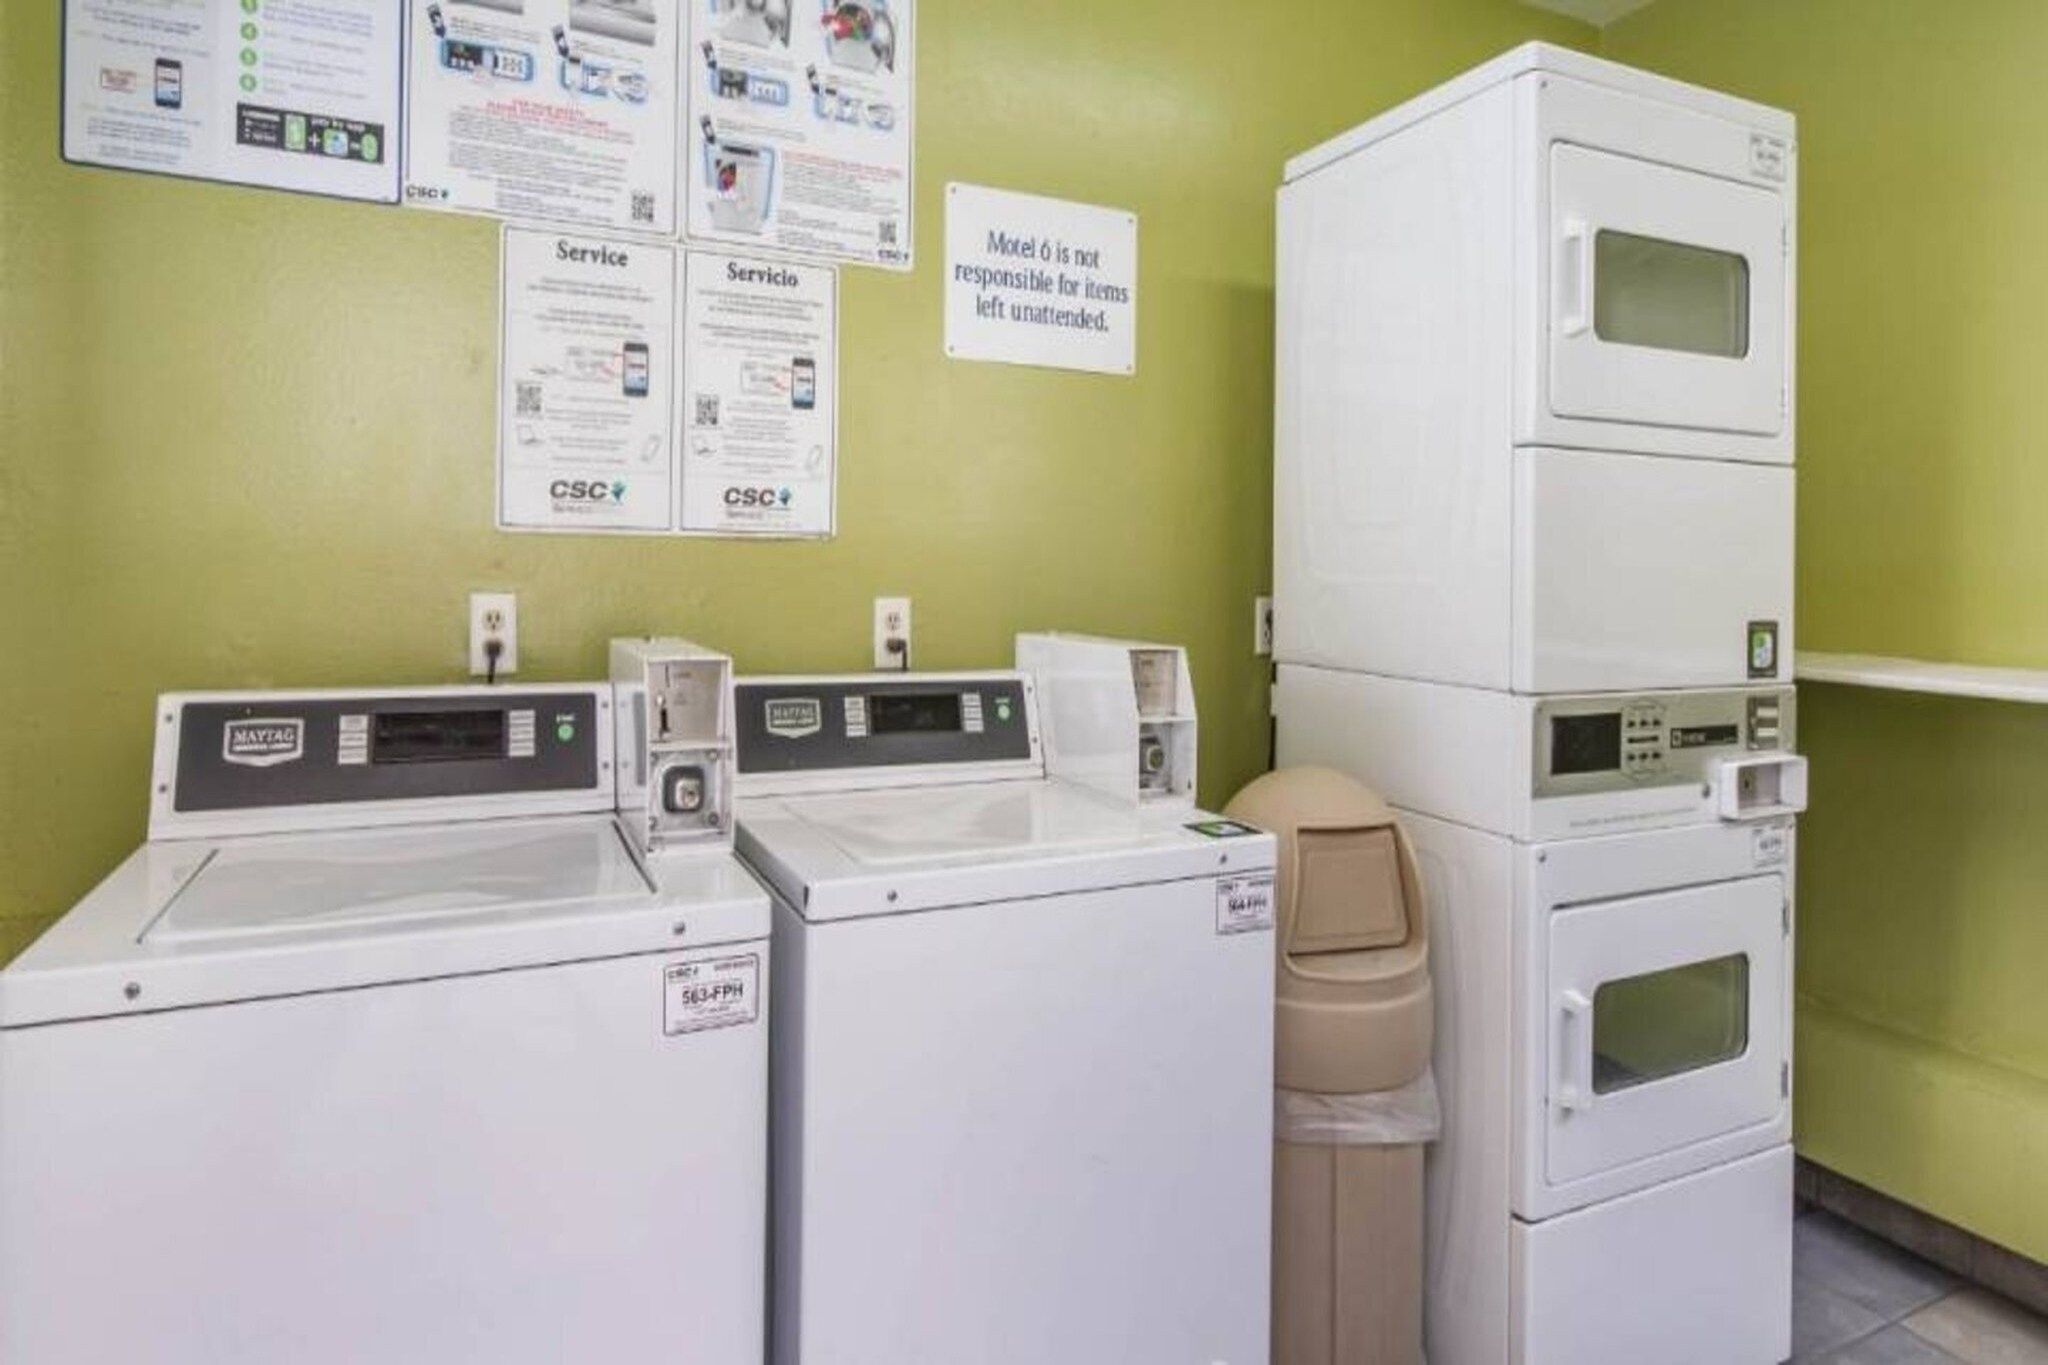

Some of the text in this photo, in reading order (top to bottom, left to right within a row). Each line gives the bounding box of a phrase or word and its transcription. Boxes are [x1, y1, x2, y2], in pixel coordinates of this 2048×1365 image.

[555, 240, 629, 267] Service
[986, 229, 1100, 269] Motel 6 is not
[727, 261, 799, 289] Servicio
[954, 263, 1129, 304] responsible for items
[976, 294, 1110, 333] left unattended.
[549, 480, 608, 499] CSC
[723, 487, 776, 507] CSC
[232, 727, 295, 744] MAYTAG
